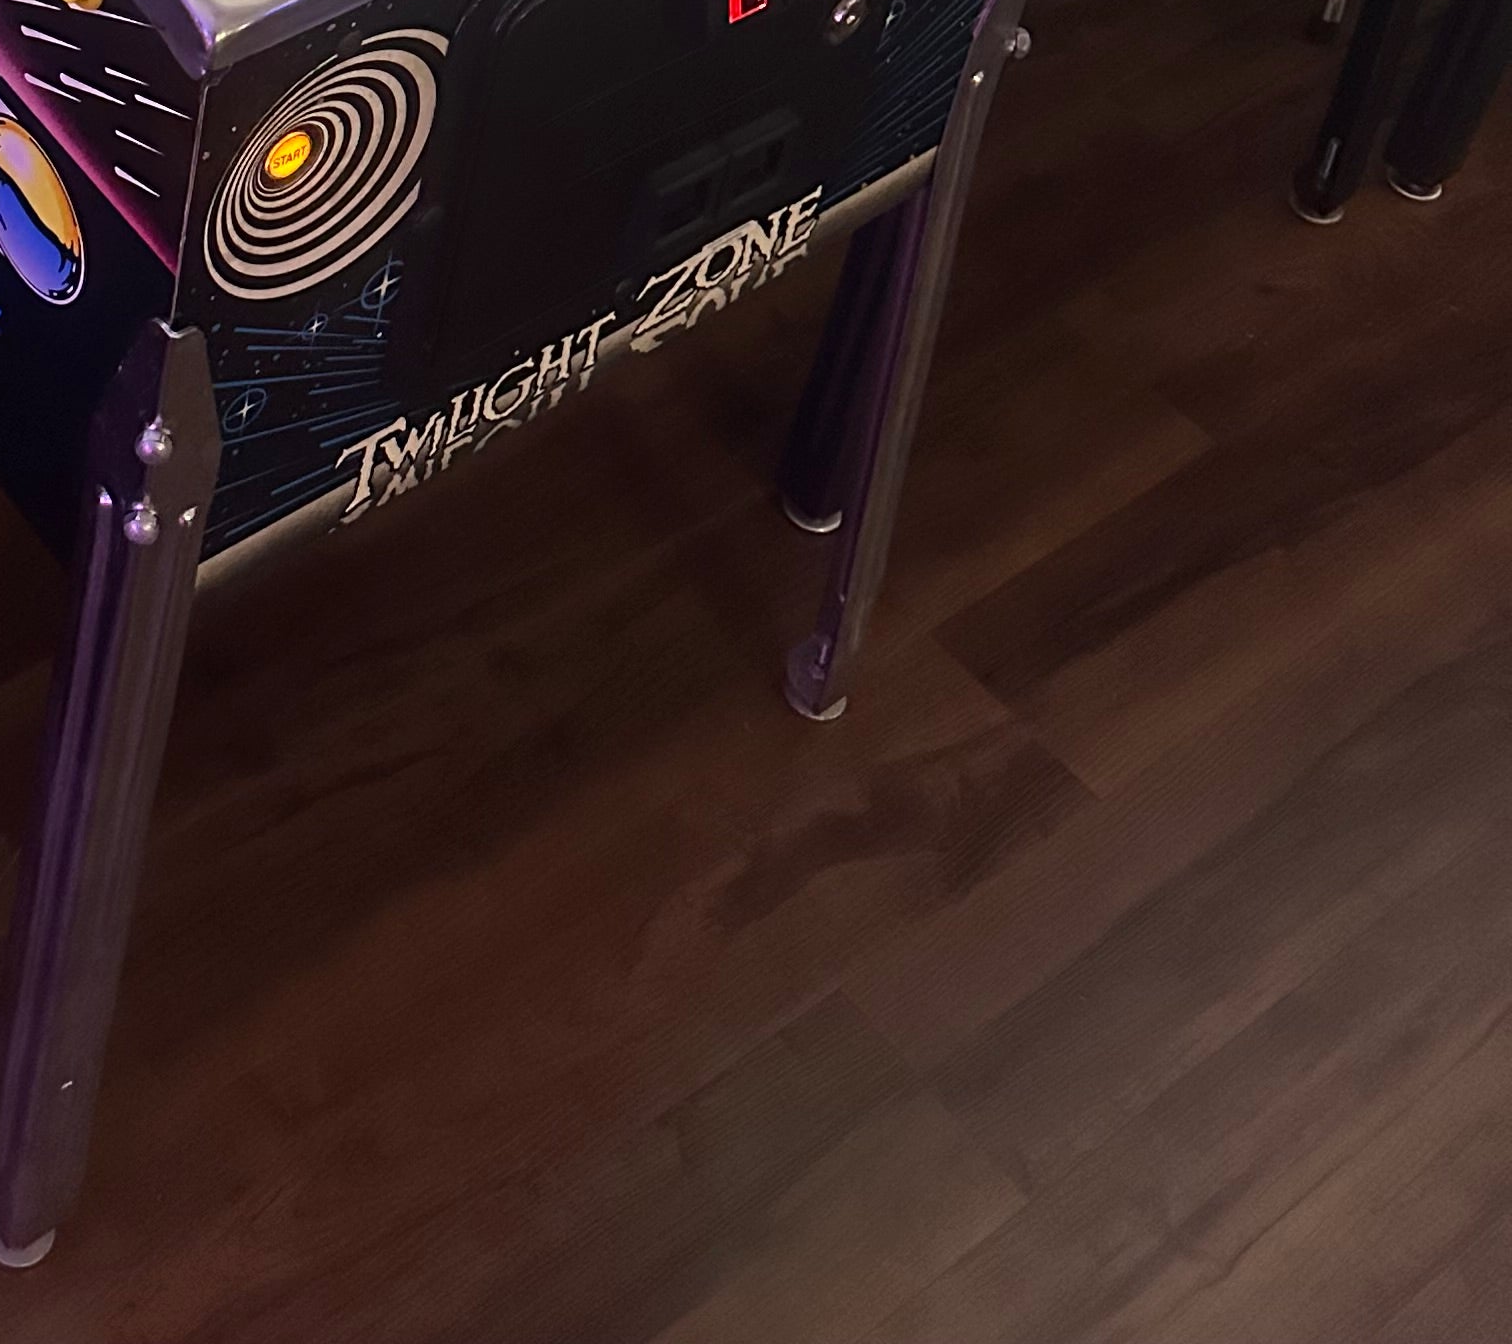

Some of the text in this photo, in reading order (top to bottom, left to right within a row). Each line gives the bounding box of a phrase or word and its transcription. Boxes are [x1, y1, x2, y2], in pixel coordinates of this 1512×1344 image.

[272, 144, 310, 170] START
[632, 185, 824, 338] ZONE
[336, 314, 616, 516] TWILIGHT
